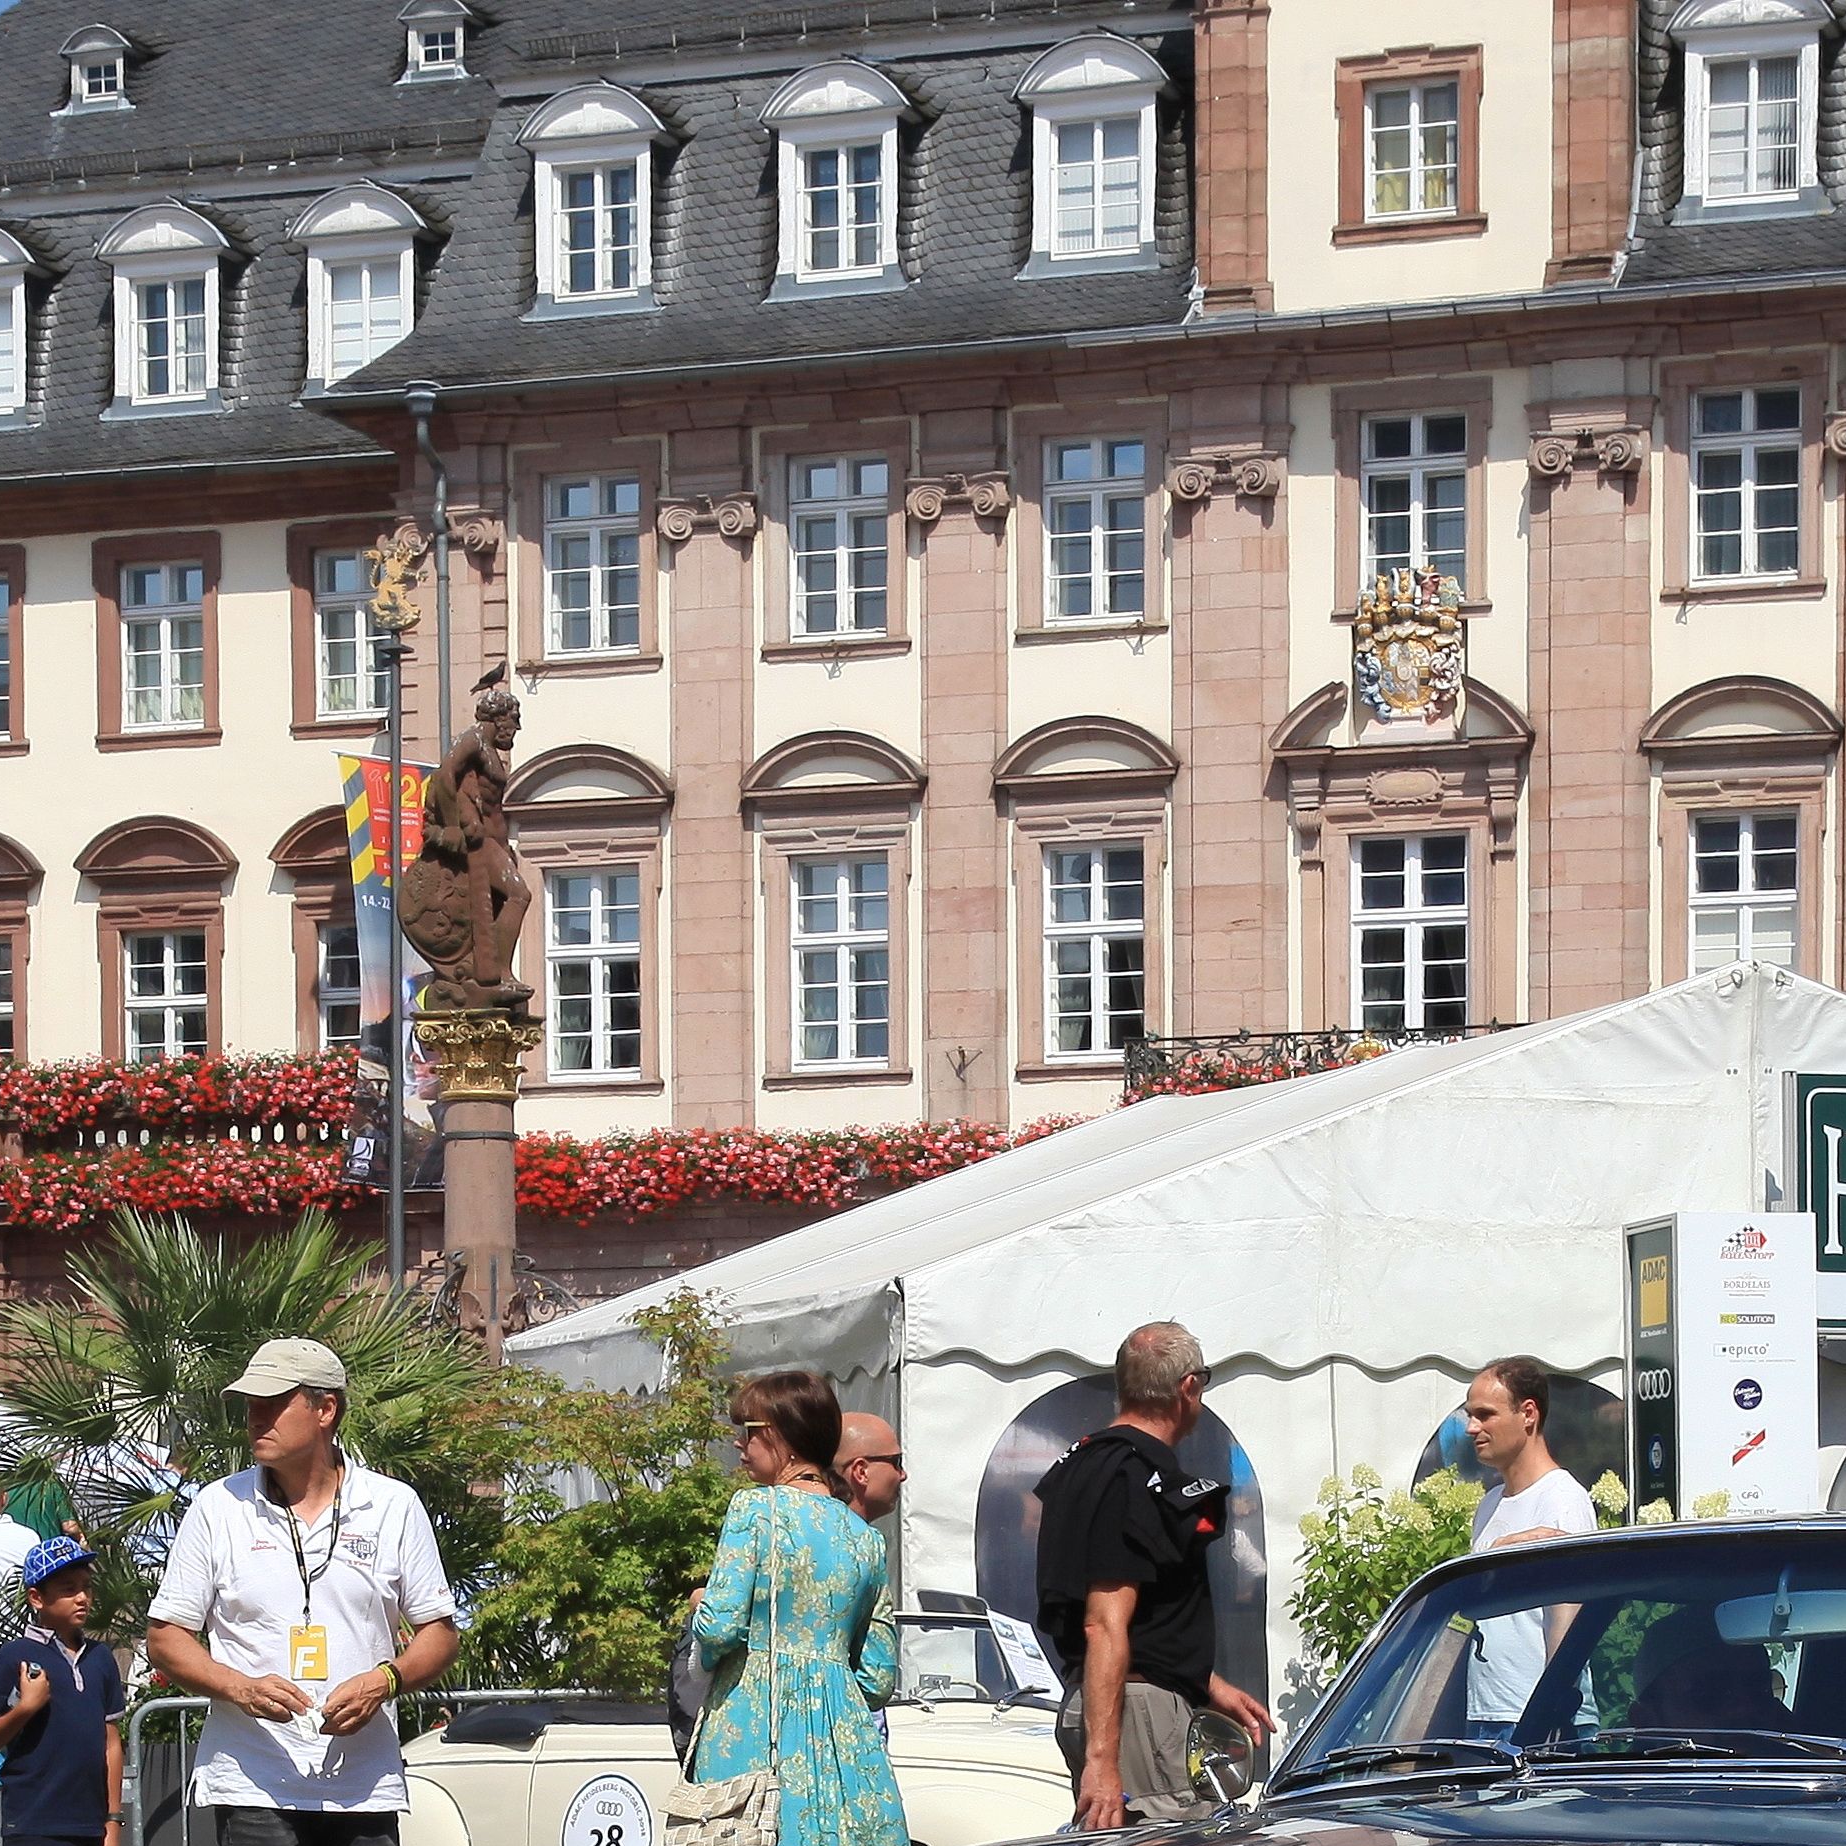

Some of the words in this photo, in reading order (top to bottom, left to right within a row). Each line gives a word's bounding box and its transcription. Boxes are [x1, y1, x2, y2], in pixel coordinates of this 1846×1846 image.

[1641, 1258, 1666, 1285] ADAC
[1723, 1281, 1771, 1290] BORDELAIS
[293, 1647, 318, 1680] F
